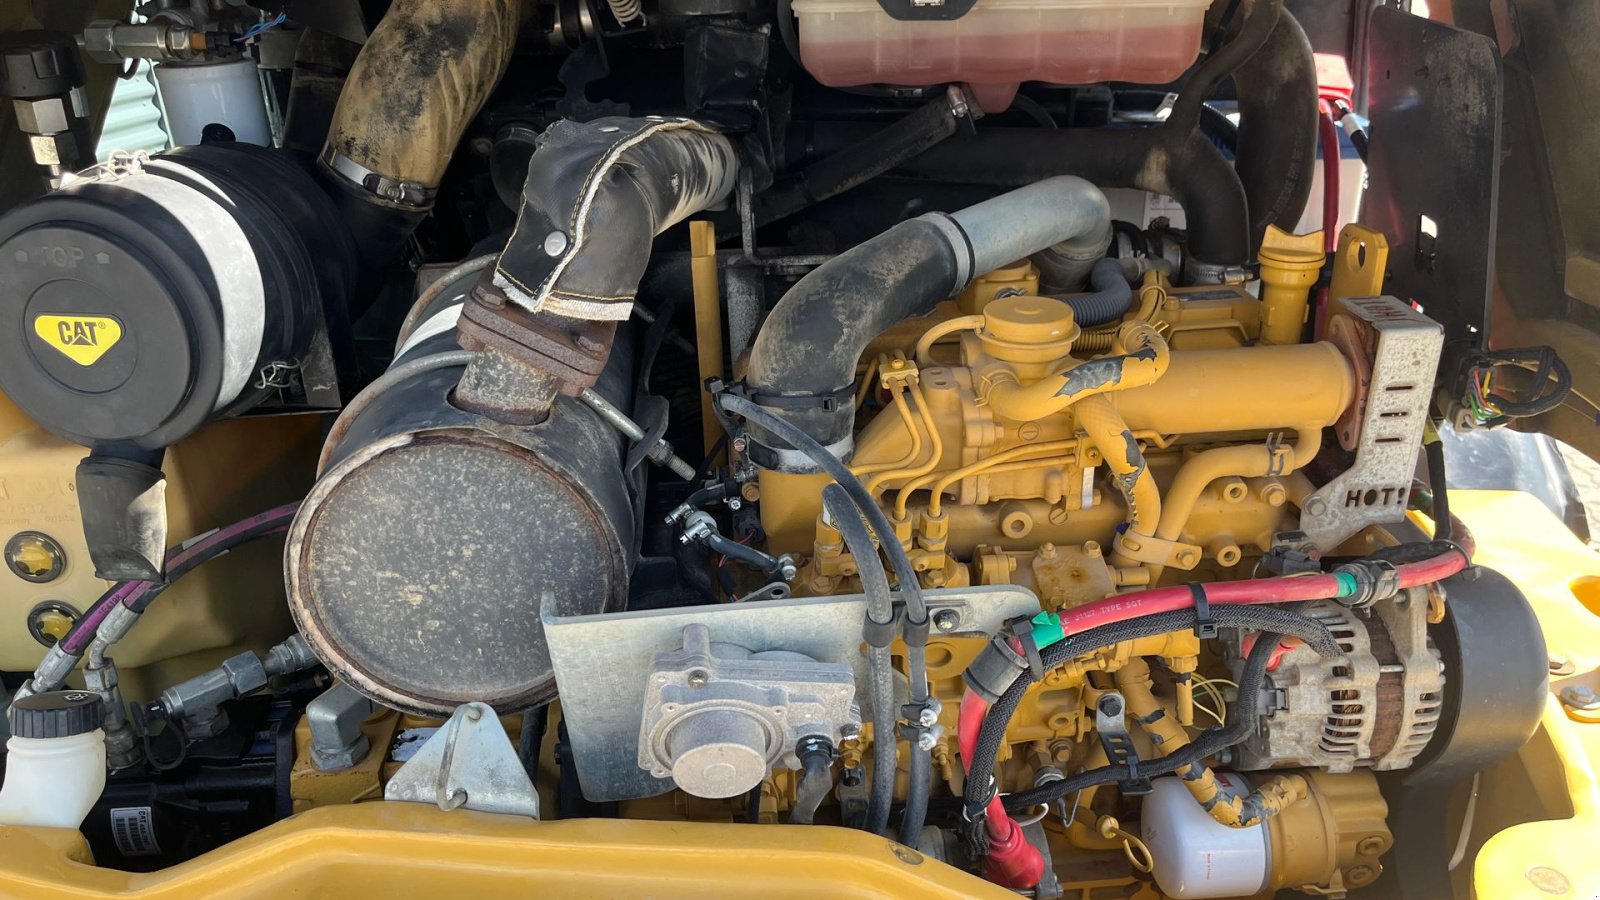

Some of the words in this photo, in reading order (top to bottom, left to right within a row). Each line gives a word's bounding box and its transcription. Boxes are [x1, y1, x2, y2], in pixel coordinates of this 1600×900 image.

[38, 246, 85, 268] TOP
[58, 321, 98, 345] CAT
[1345, 487, 1405, 508] HOT!
[1100, 603, 1122, 614] TYPE
[1126, 600, 1142, 609] SGT
